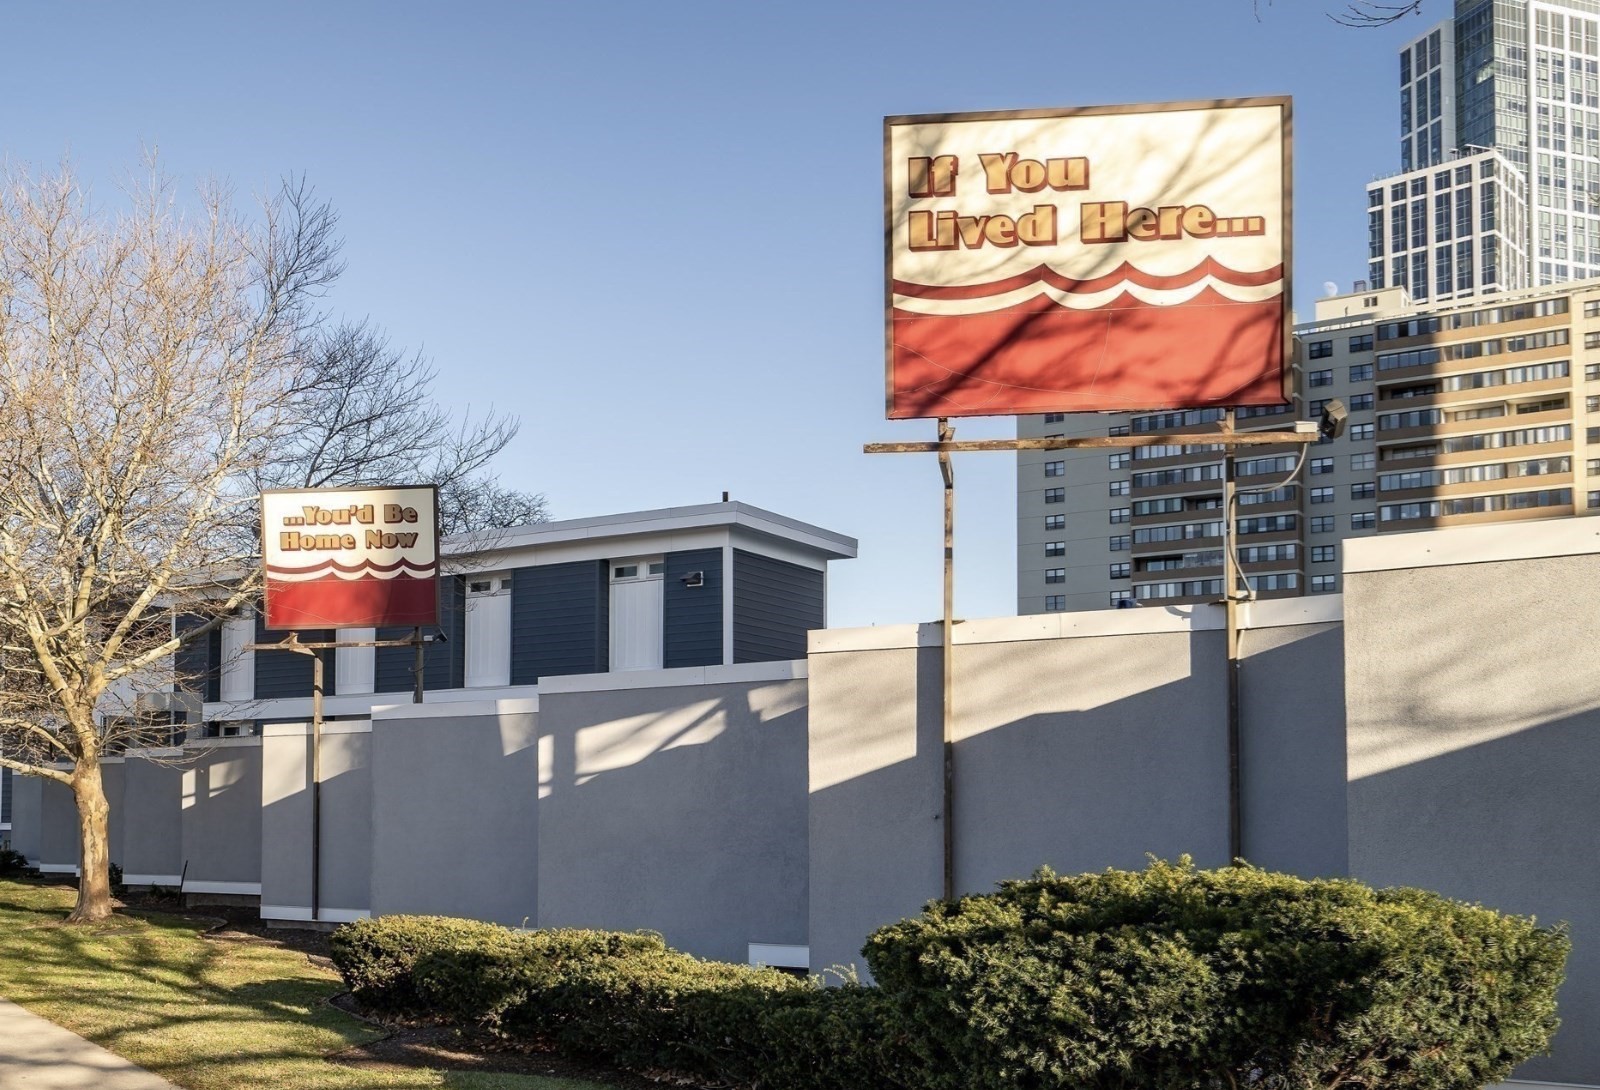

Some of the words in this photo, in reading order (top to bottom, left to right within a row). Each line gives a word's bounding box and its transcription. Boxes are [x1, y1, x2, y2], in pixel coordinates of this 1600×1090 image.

[908, 154, 959, 198] If
[977, 151, 1090, 195] You
[908, 204, 1058, 252] Lived
[1080, 200, 1266, 244] Here...
[283, 504, 375, 526] ...You'd
[384, 503, 418, 523] Be
[280, 531, 356, 551] Home
[365, 529, 419, 549] Now
